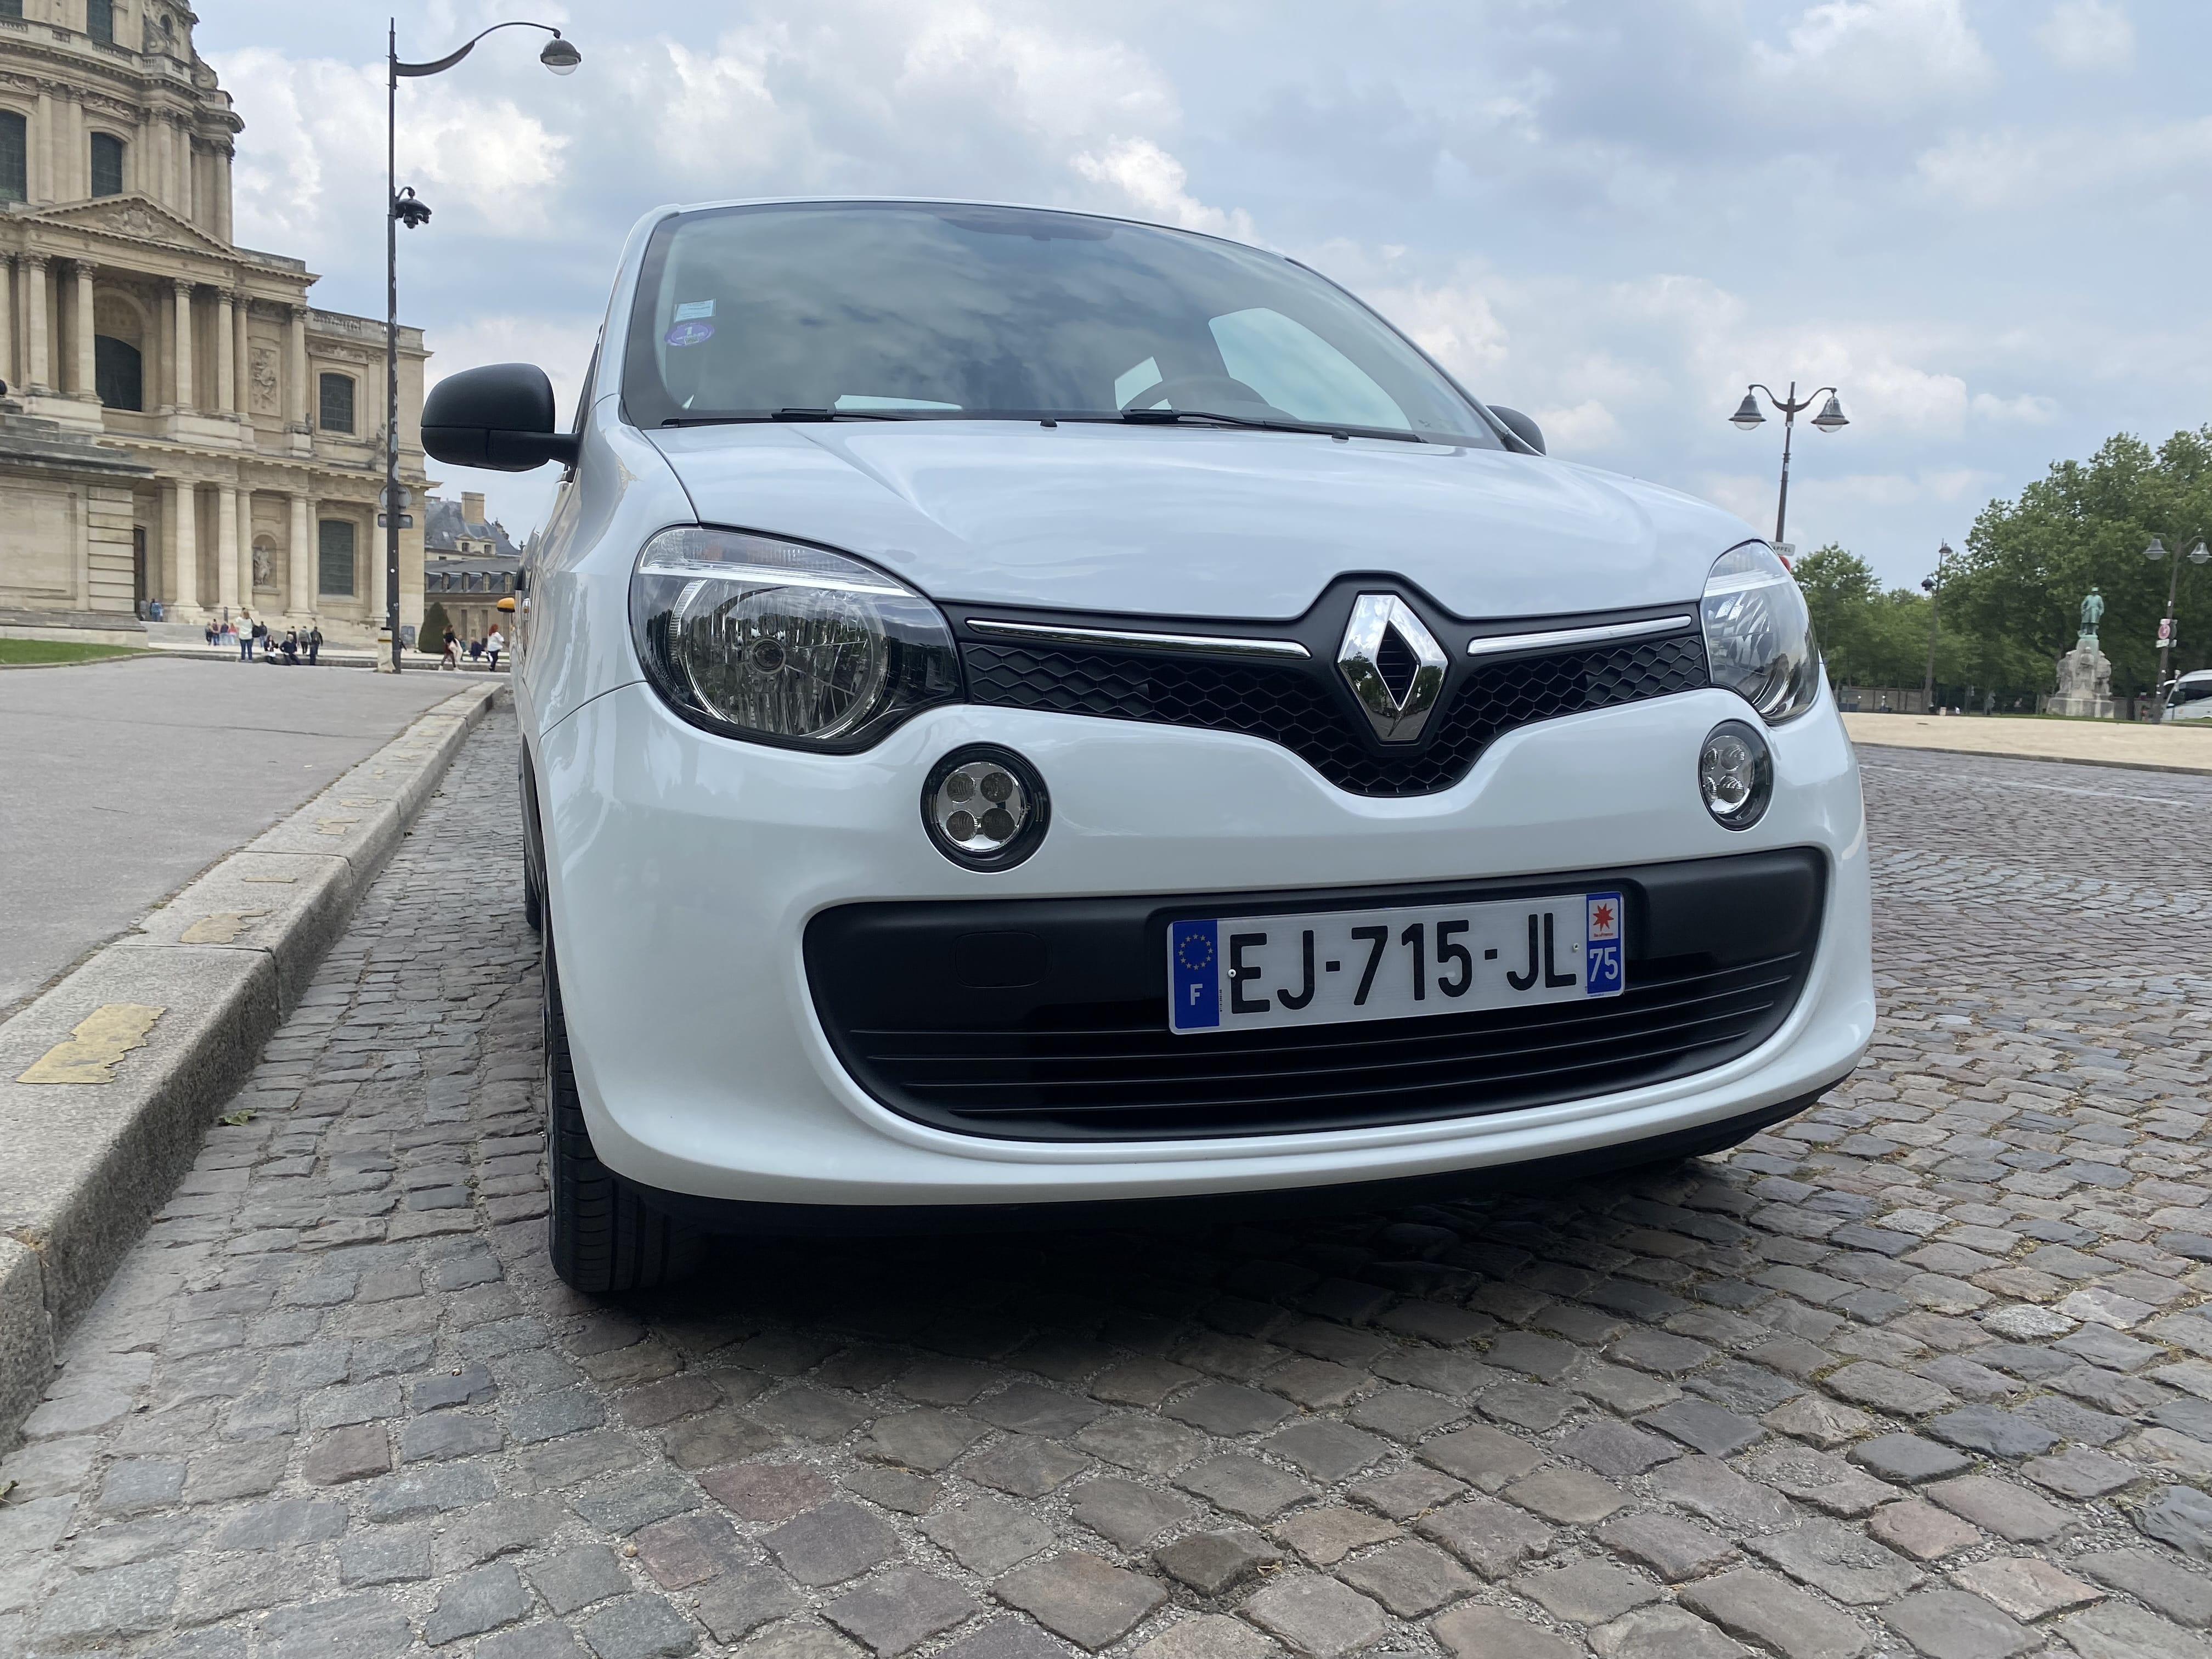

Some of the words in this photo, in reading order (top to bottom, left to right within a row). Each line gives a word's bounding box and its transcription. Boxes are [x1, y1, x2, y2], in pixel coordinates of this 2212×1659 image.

[1230, 913, 1577, 1014] EJ-715-JL
[1589, 946, 1618, 982] 75
[1190, 983, 1203, 1006] F
